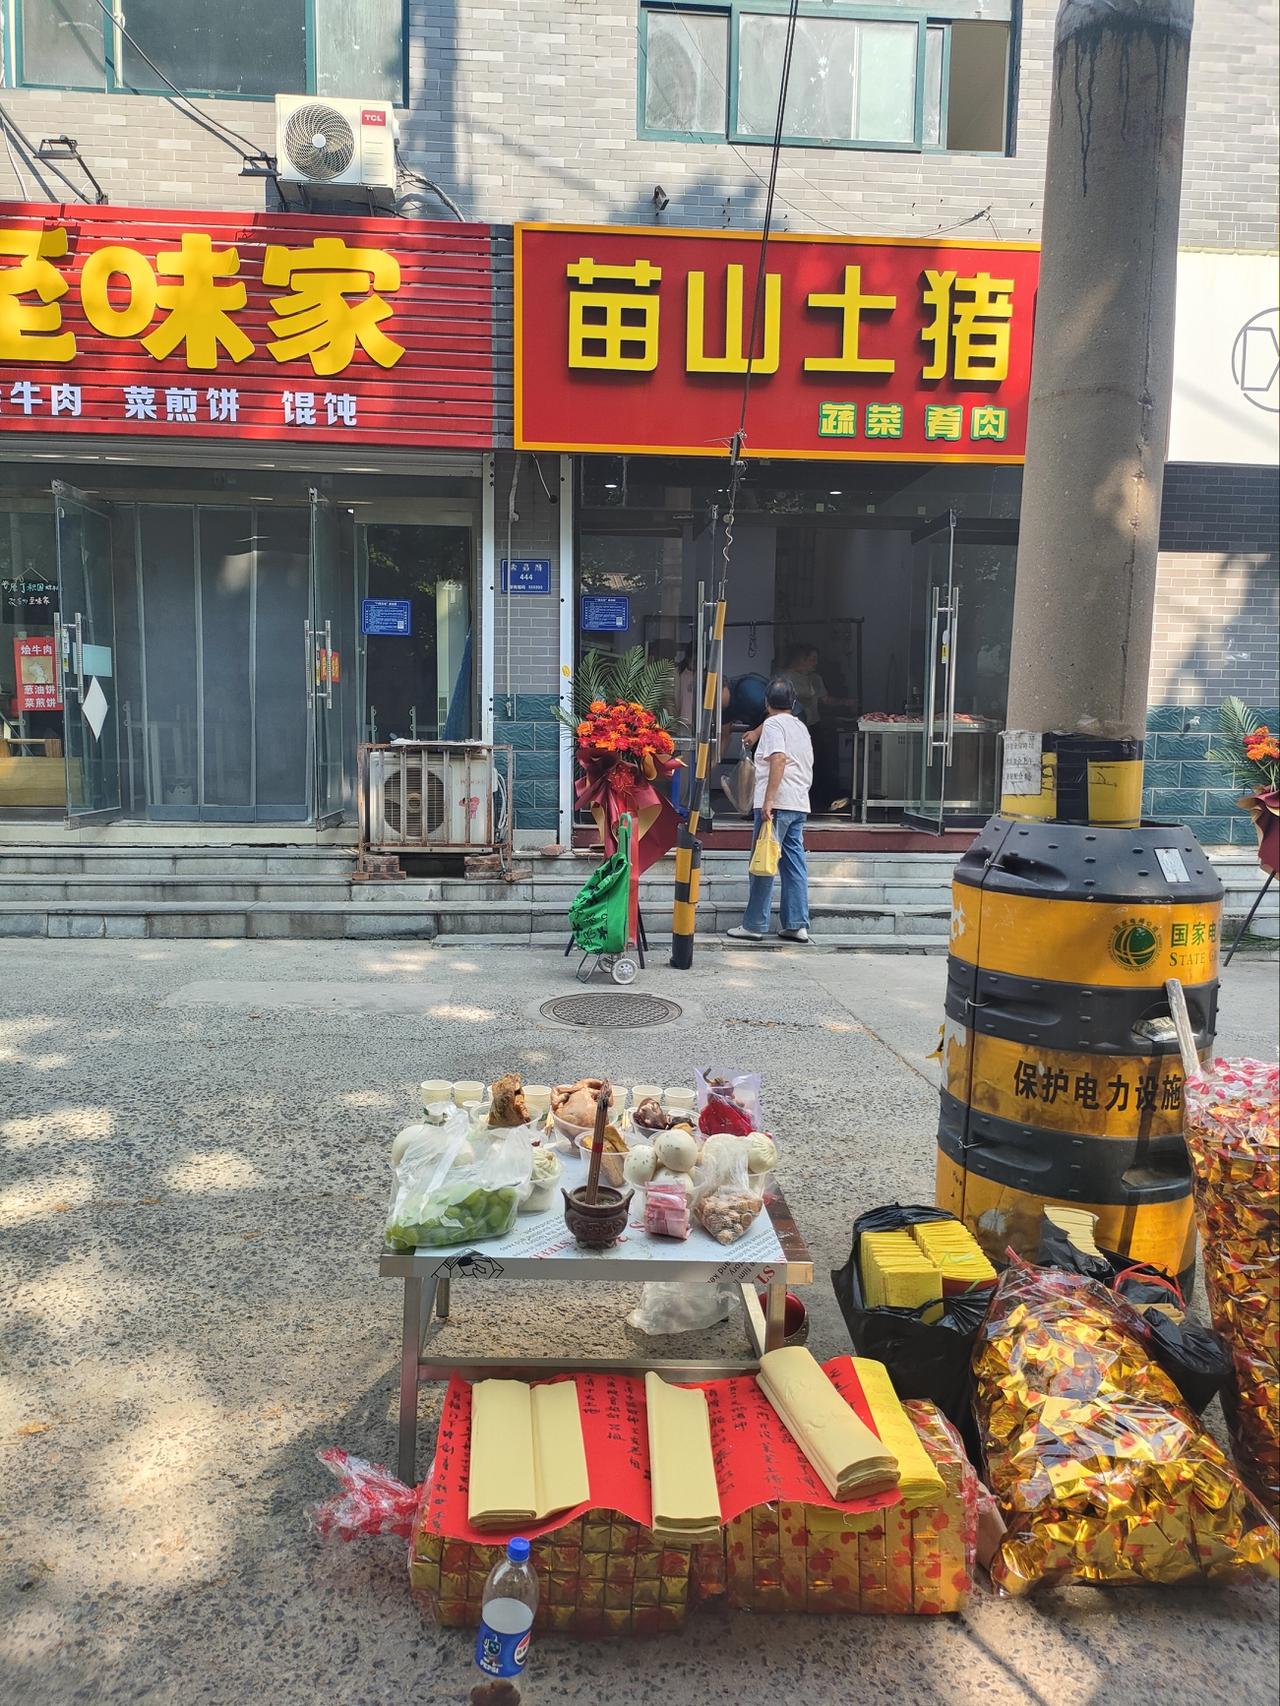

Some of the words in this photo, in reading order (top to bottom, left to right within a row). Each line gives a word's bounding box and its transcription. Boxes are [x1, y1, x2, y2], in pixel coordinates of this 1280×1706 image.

[364, 114, 383, 122] TCL
[566, 257, 1015, 382] 苗山土猪
[0, 381, 82, 417] 牛肉
[123, 386, 240, 423] 菜煎饼
[281, 390, 358, 427] 馄饨
[819, 401, 902, 438] 蔬菜
[519, 573, 534, 581] 444
[23, 684, 56, 695] 葱油饼
[24, 697, 57, 708] 菜煎饼
[1169, 951, 1206, 967] STATE
[1013, 1059, 1183, 1112] 保护电力设施
